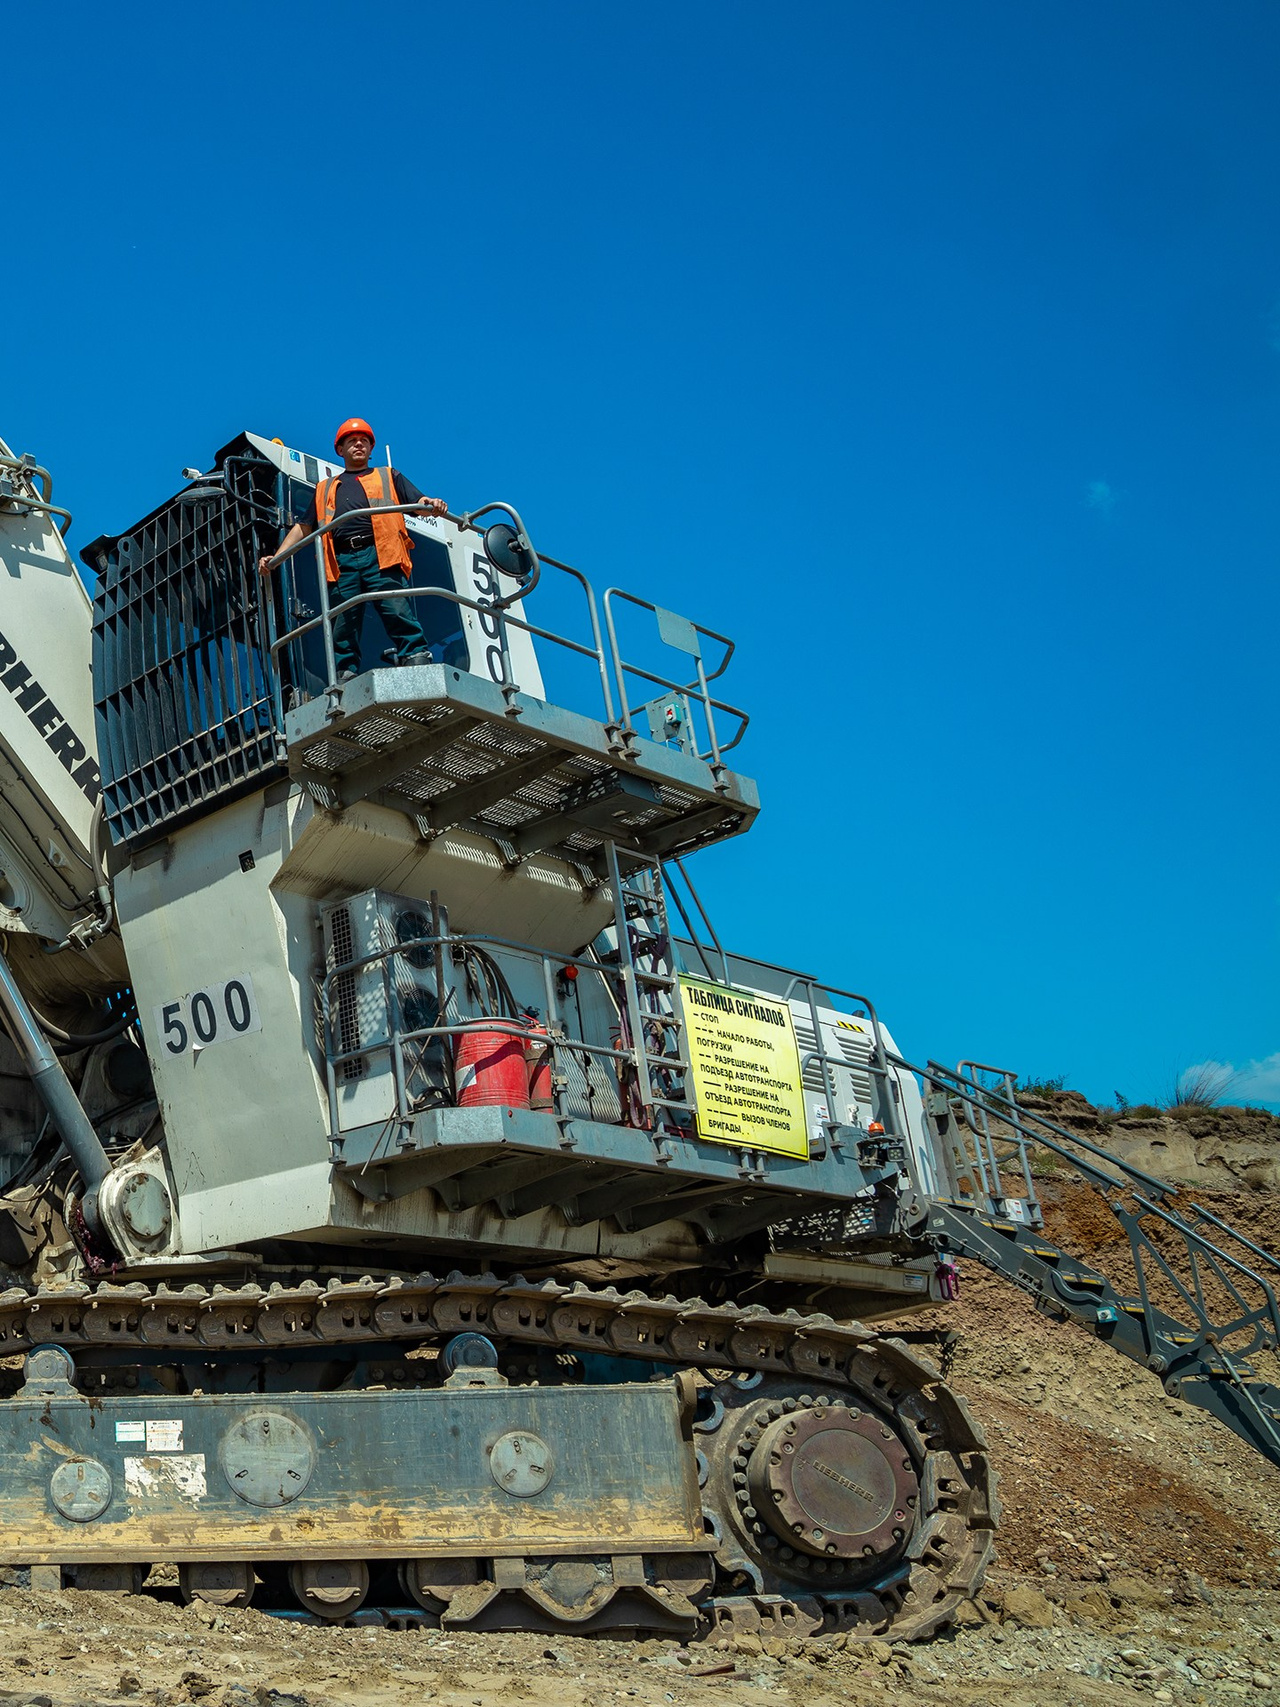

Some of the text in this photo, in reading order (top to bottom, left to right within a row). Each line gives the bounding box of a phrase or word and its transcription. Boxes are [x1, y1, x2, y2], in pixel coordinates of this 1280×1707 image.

[162, 980, 251, 1054] 500
[687, 986, 786, 1028] ТАБЛИЦА СИГНАЛОВ
[700, 1012, 720, 1024] СТОП
[696, 1036, 733, 1053] ПОГРУЗКИ
[716, 1029, 775, 1051] НАЧАЛО РАБОТЫ,
[714, 1054, 770, 1074] РАЗРЕШЕНИЕ НА
[700, 1063, 793, 1092] ПОДЪЕЗД АВТОТРАНСПОРТА
[724, 1083, 780, 1102] РАЗРЕШЕНИЕ НА
[704, 1091, 792, 1117] ОТЪЕЗД АВТОТРАНСПОРТА
[741, 1112, 791, 1131] ВЫЗОВ ЧЛЕНОВ
[812, 1459, 875, 1503] LIEBHERR
